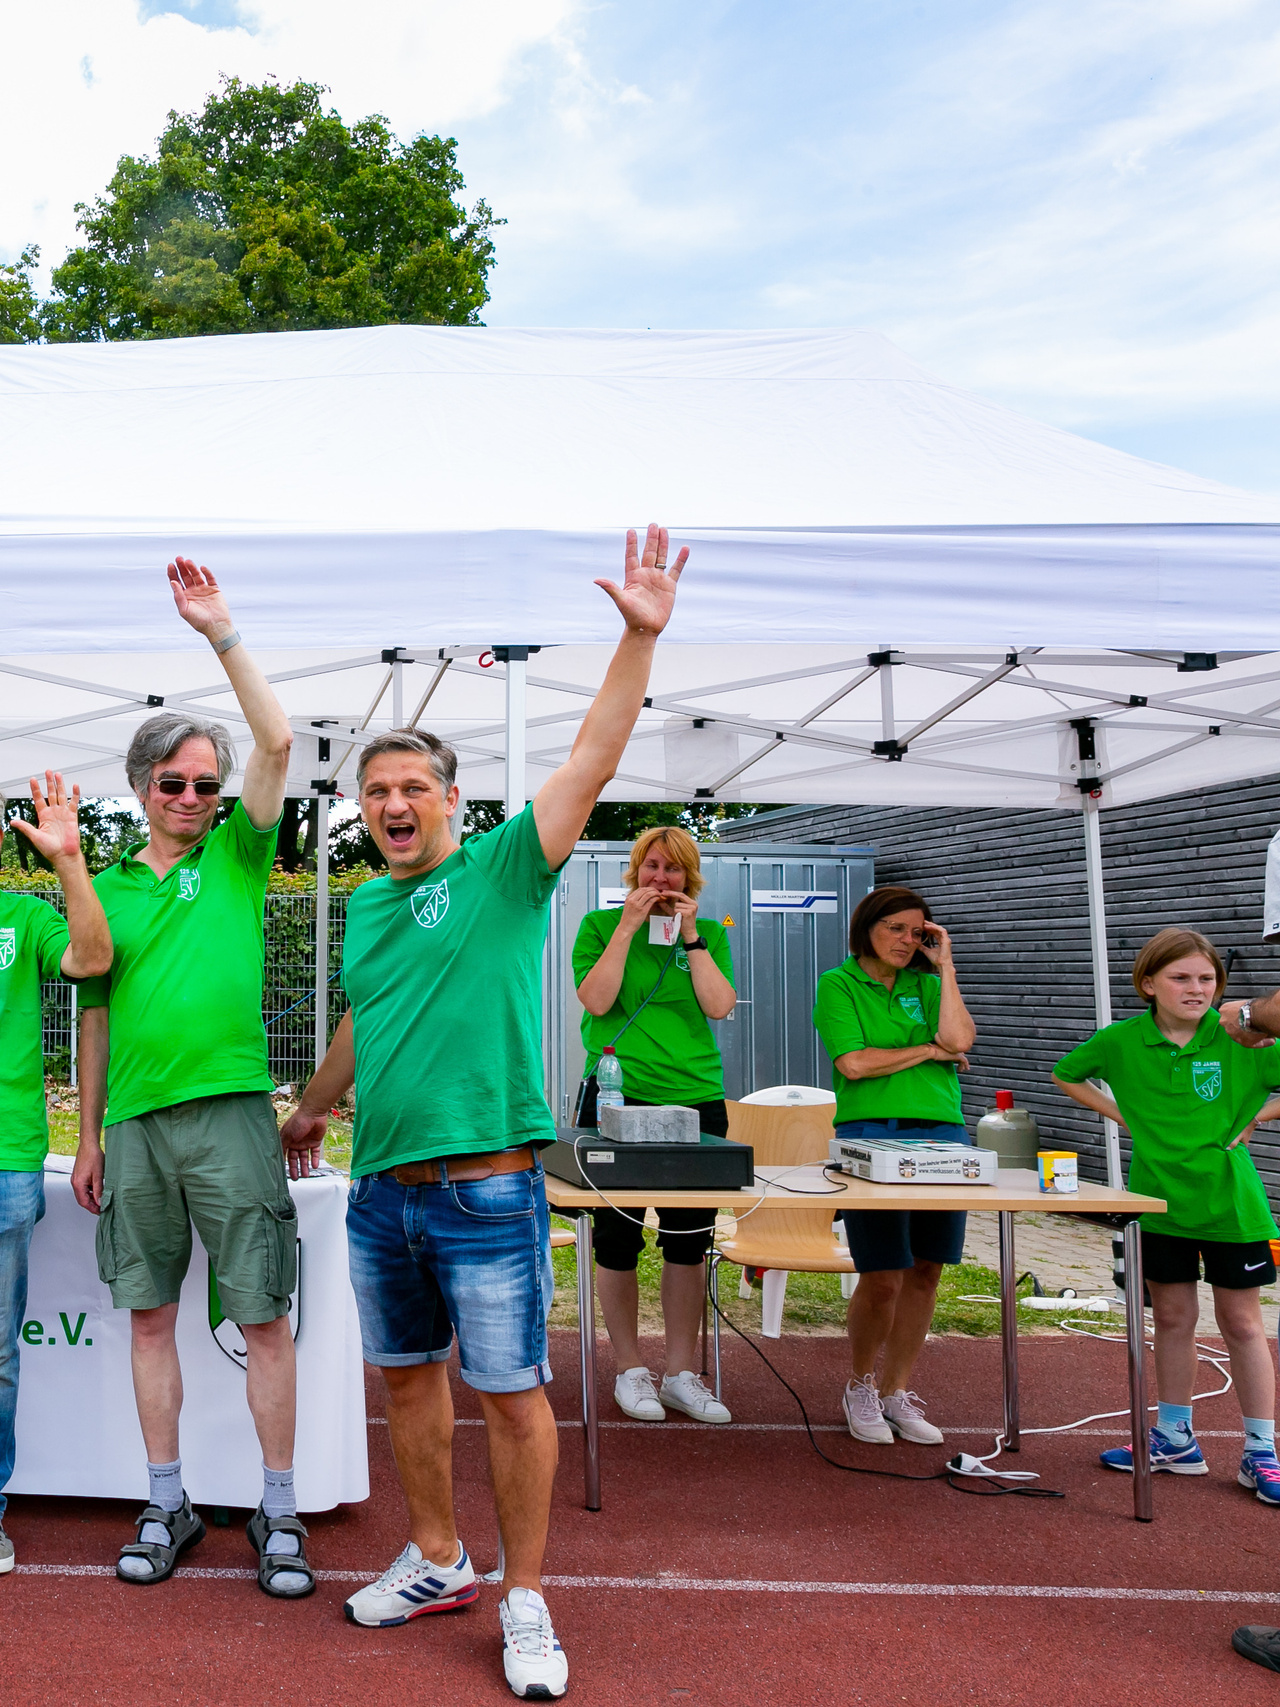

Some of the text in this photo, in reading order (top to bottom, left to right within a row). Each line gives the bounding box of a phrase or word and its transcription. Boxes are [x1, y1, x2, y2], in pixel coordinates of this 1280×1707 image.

[423, 887, 446, 924] SVS
[1201, 1075, 1220, 1098] SVS
[21, 1311, 94, 1346] e.V.
